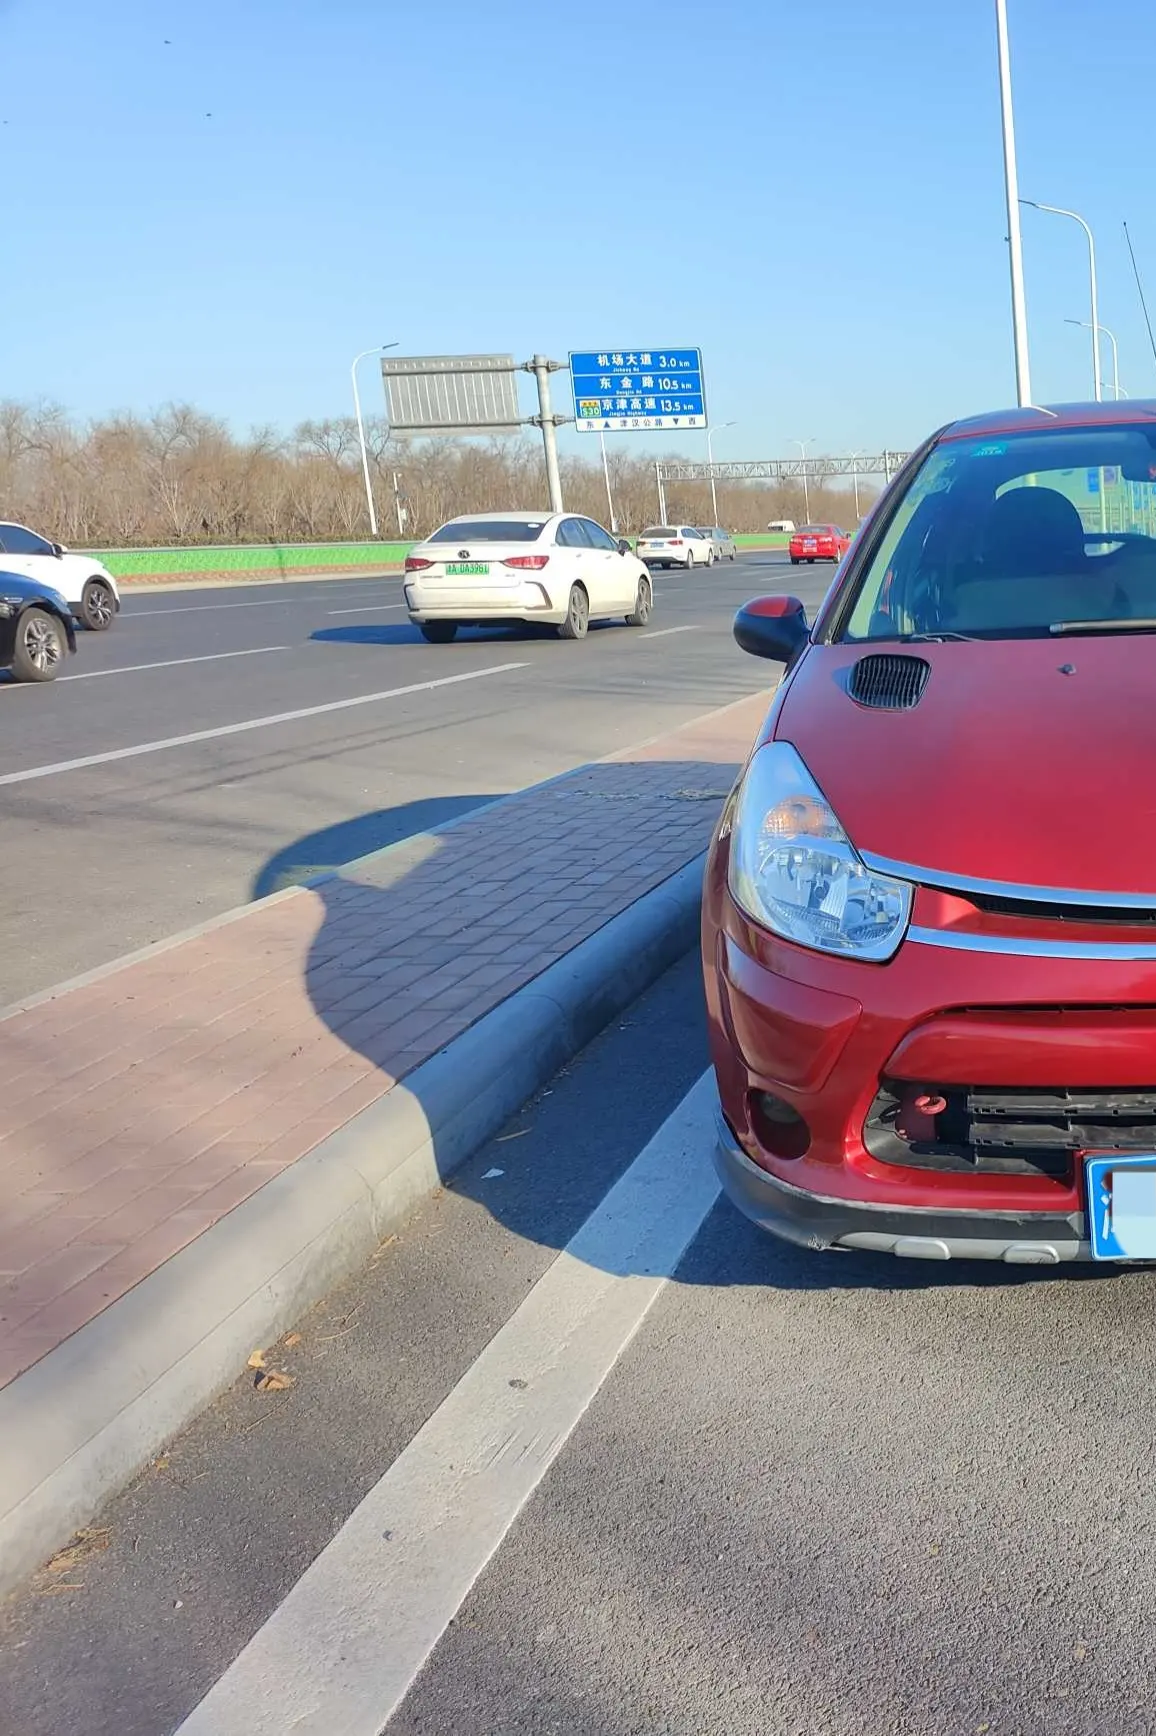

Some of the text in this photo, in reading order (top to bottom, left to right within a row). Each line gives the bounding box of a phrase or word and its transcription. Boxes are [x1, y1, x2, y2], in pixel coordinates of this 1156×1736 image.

[598, 353, 690, 368] 机场大道 3.0 km
[600, 375, 655, 389] 东金路
[658, 377, 679, 391] 10.5
[602, 398, 656, 411] 京津高速
[660, 399, 681, 412] 13.5
[683, 403, 694, 411] km
[620, 418, 663, 427] 津汉公路
